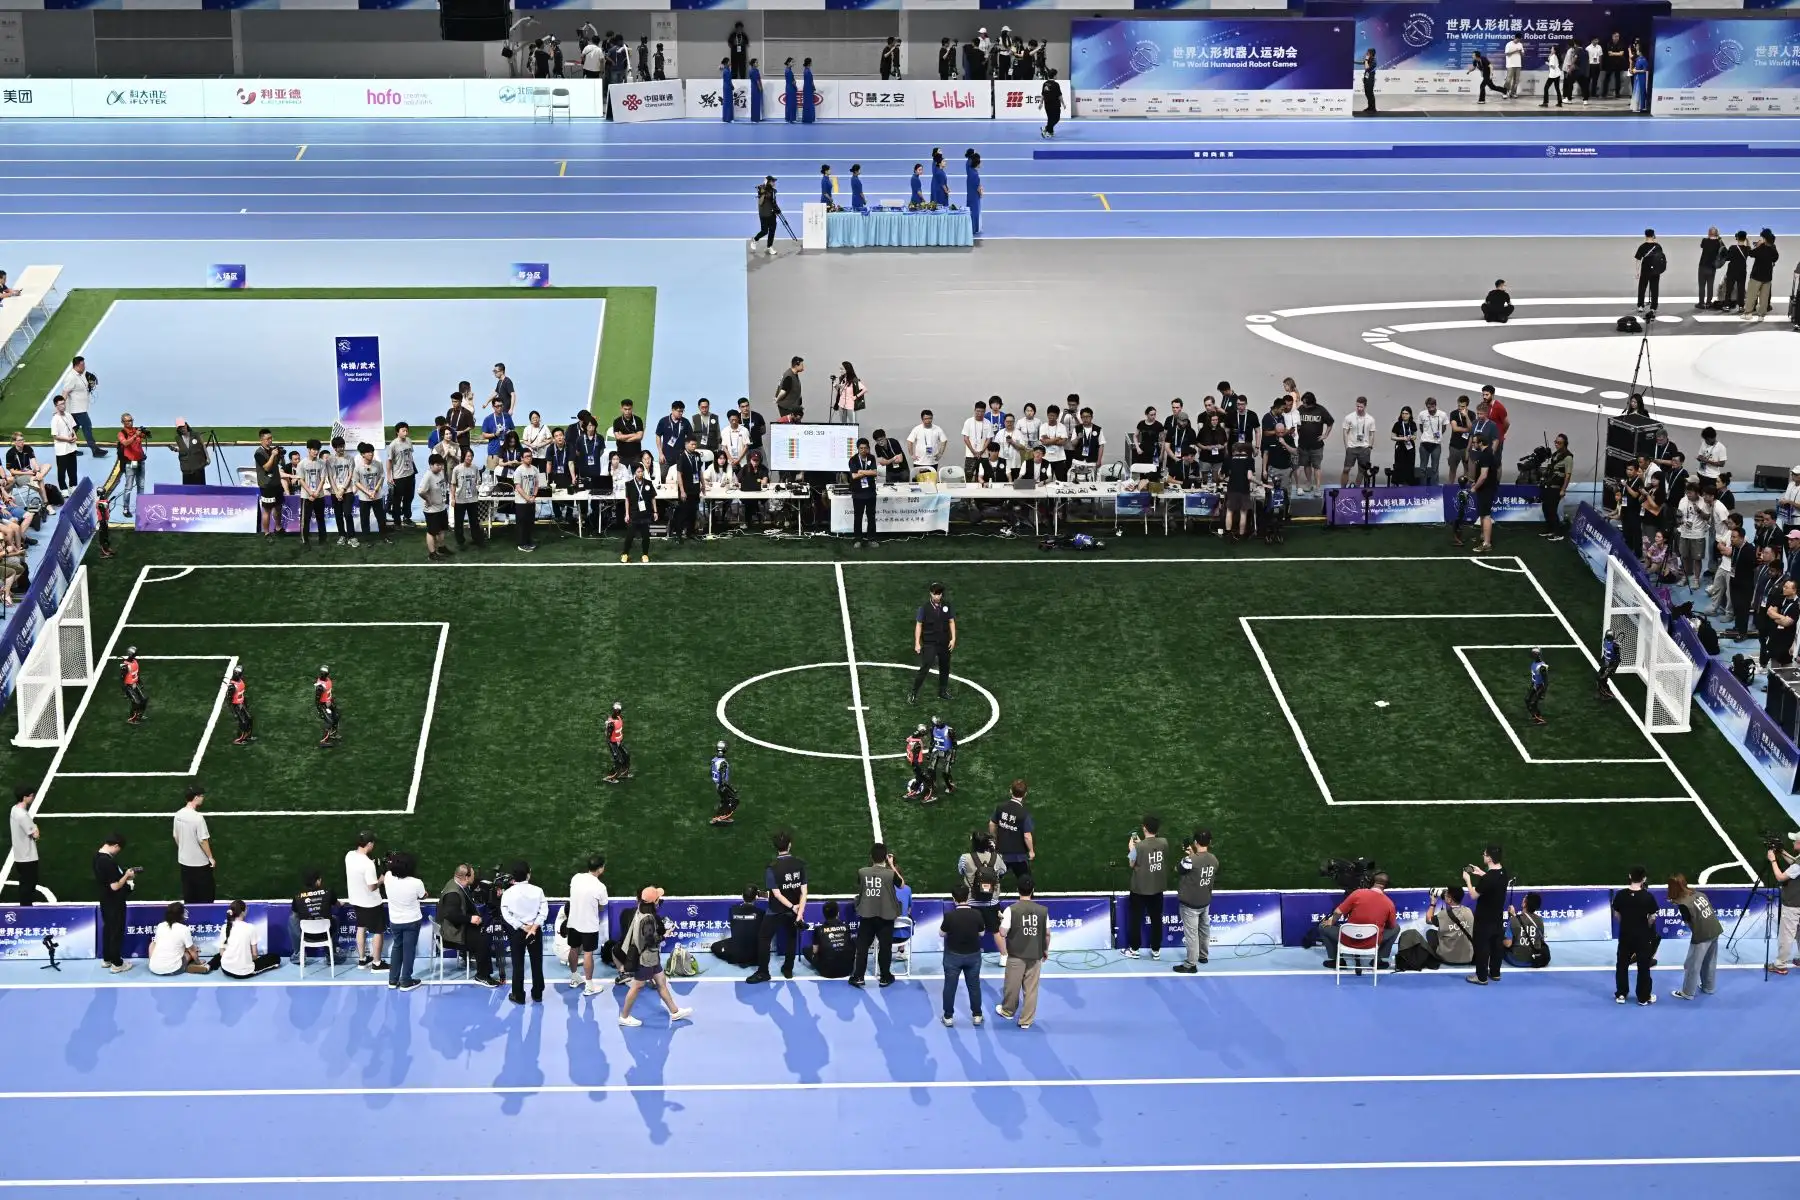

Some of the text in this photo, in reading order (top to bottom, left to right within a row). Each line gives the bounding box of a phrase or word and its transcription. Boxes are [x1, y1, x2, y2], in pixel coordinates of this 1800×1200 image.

[1446, 19, 1574, 32] 世界人形机器人运动会
[1173, 46, 1298, 59] 世界人形机器人运动会
[3, 89, 33, 104] 美团
[130, 89, 167, 98] 科大讯飞
[261, 89, 302, 99] 利亚德
[367, 89, 402, 105] hofo
[644, 94, 674, 102] 中国联通
[866, 93, 905, 103] 慧之安
[932, 90, 976, 108] bilibili
[1148, 851, 1163, 864] HB
[1149, 863, 1162, 872] 098
[1200, 866, 1214, 878] HB
[784, 871, 800, 881] 裁判
[865, 876, 882, 888] HB
[866, 888, 881, 897] 002
[1693, 896, 1709, 911] HB
[1022, 914, 1038, 927] HB
[1023, 927, 1038, 936] 053
[1520, 926, 1537, 937] HB
